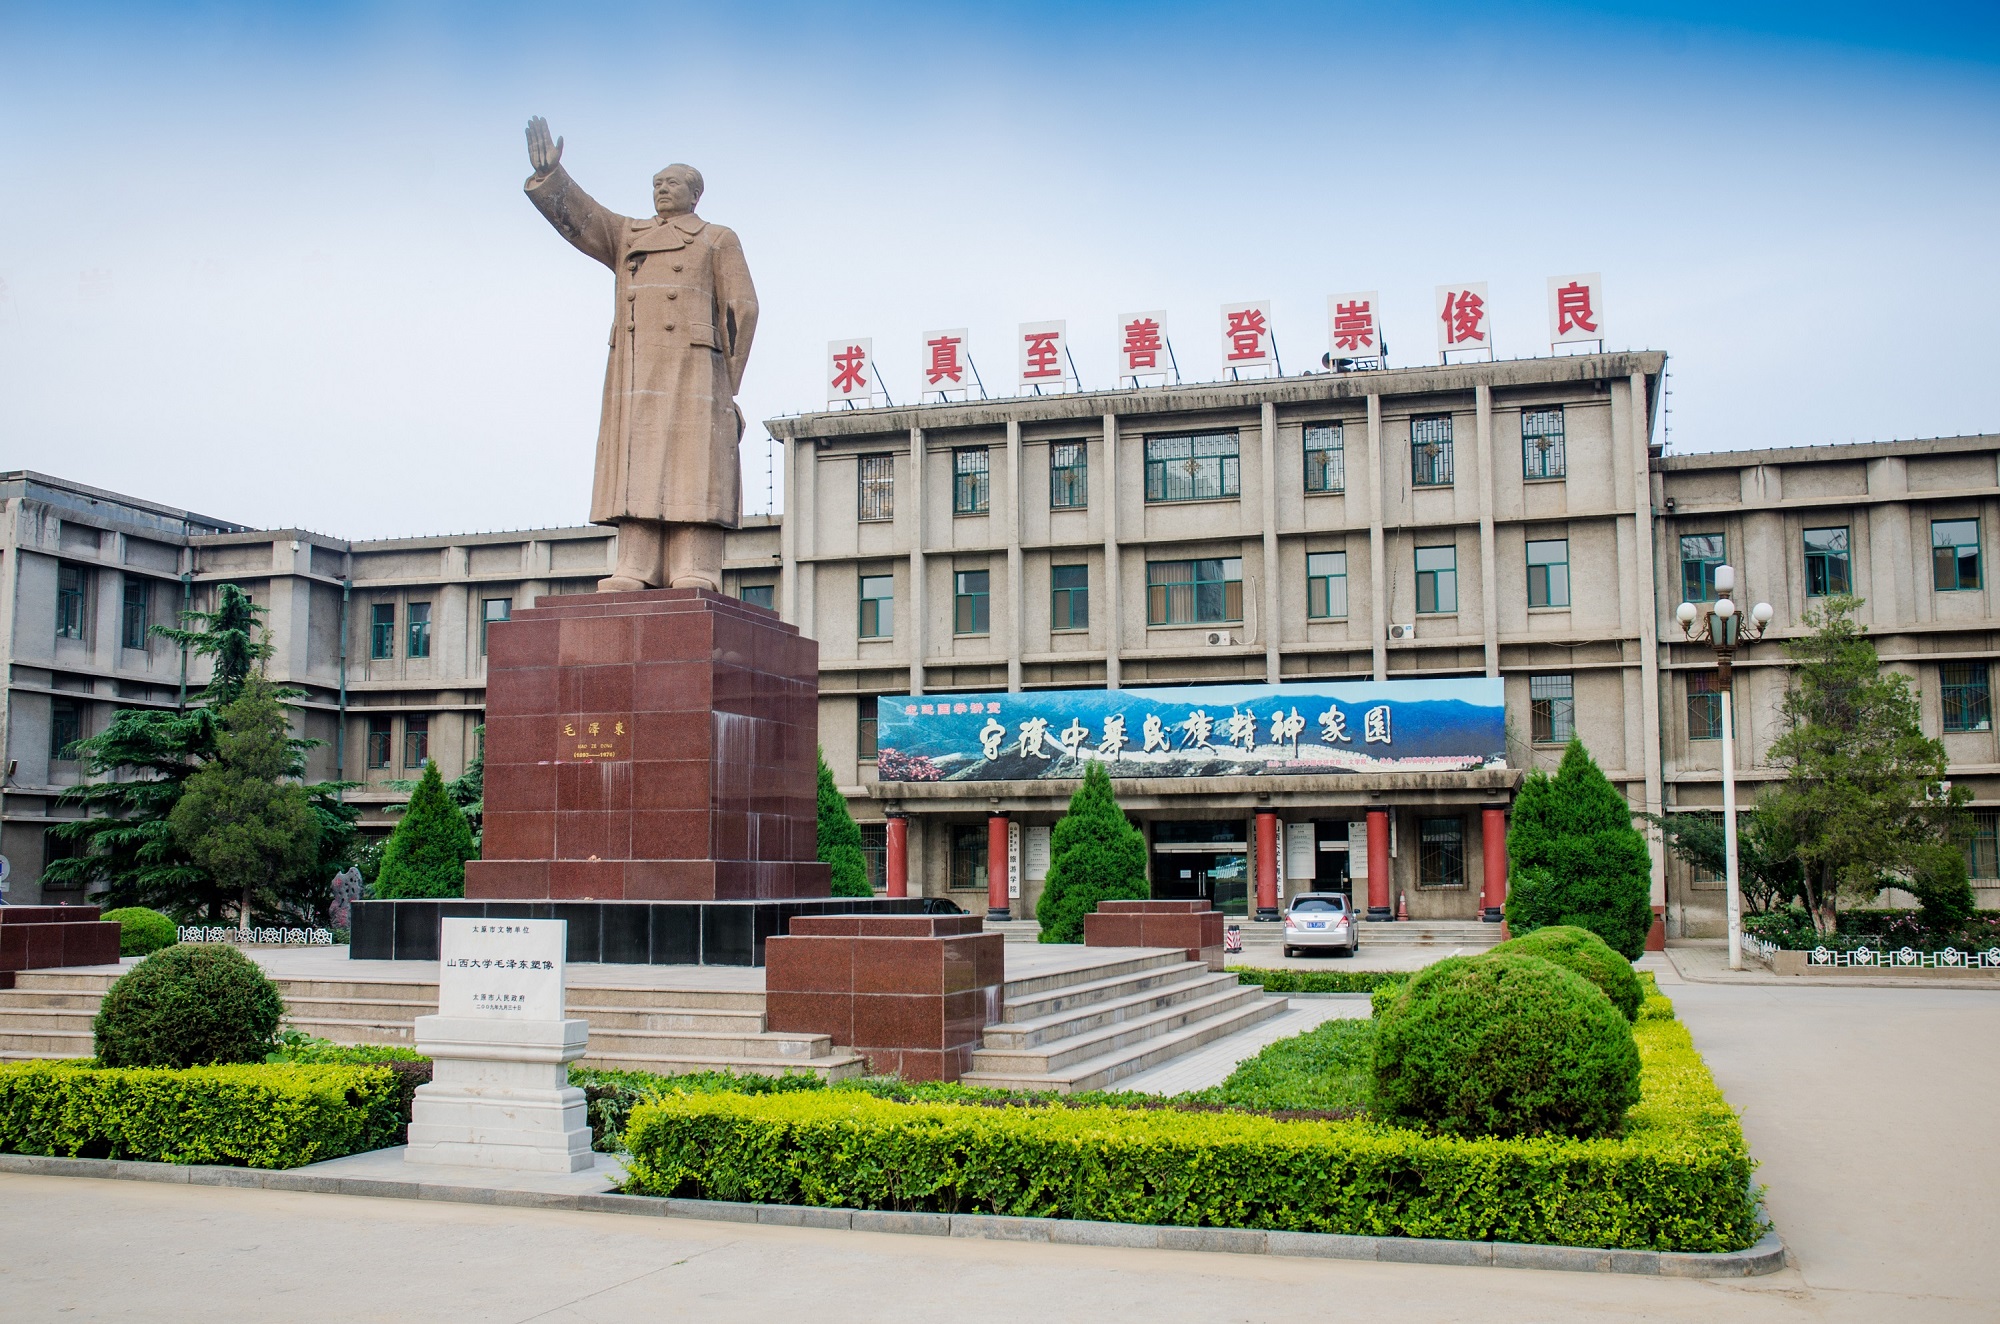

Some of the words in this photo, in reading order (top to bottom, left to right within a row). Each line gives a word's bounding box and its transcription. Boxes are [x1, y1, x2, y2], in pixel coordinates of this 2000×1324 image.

[832, 281, 1600, 394] 求真至善登崇俊良
[472, 925, 530, 934] 太原市文物单位
[447, 958, 554, 970] 山西大学毛泽东塑像
[472, 993, 526, 1002] 太原市人民政府
